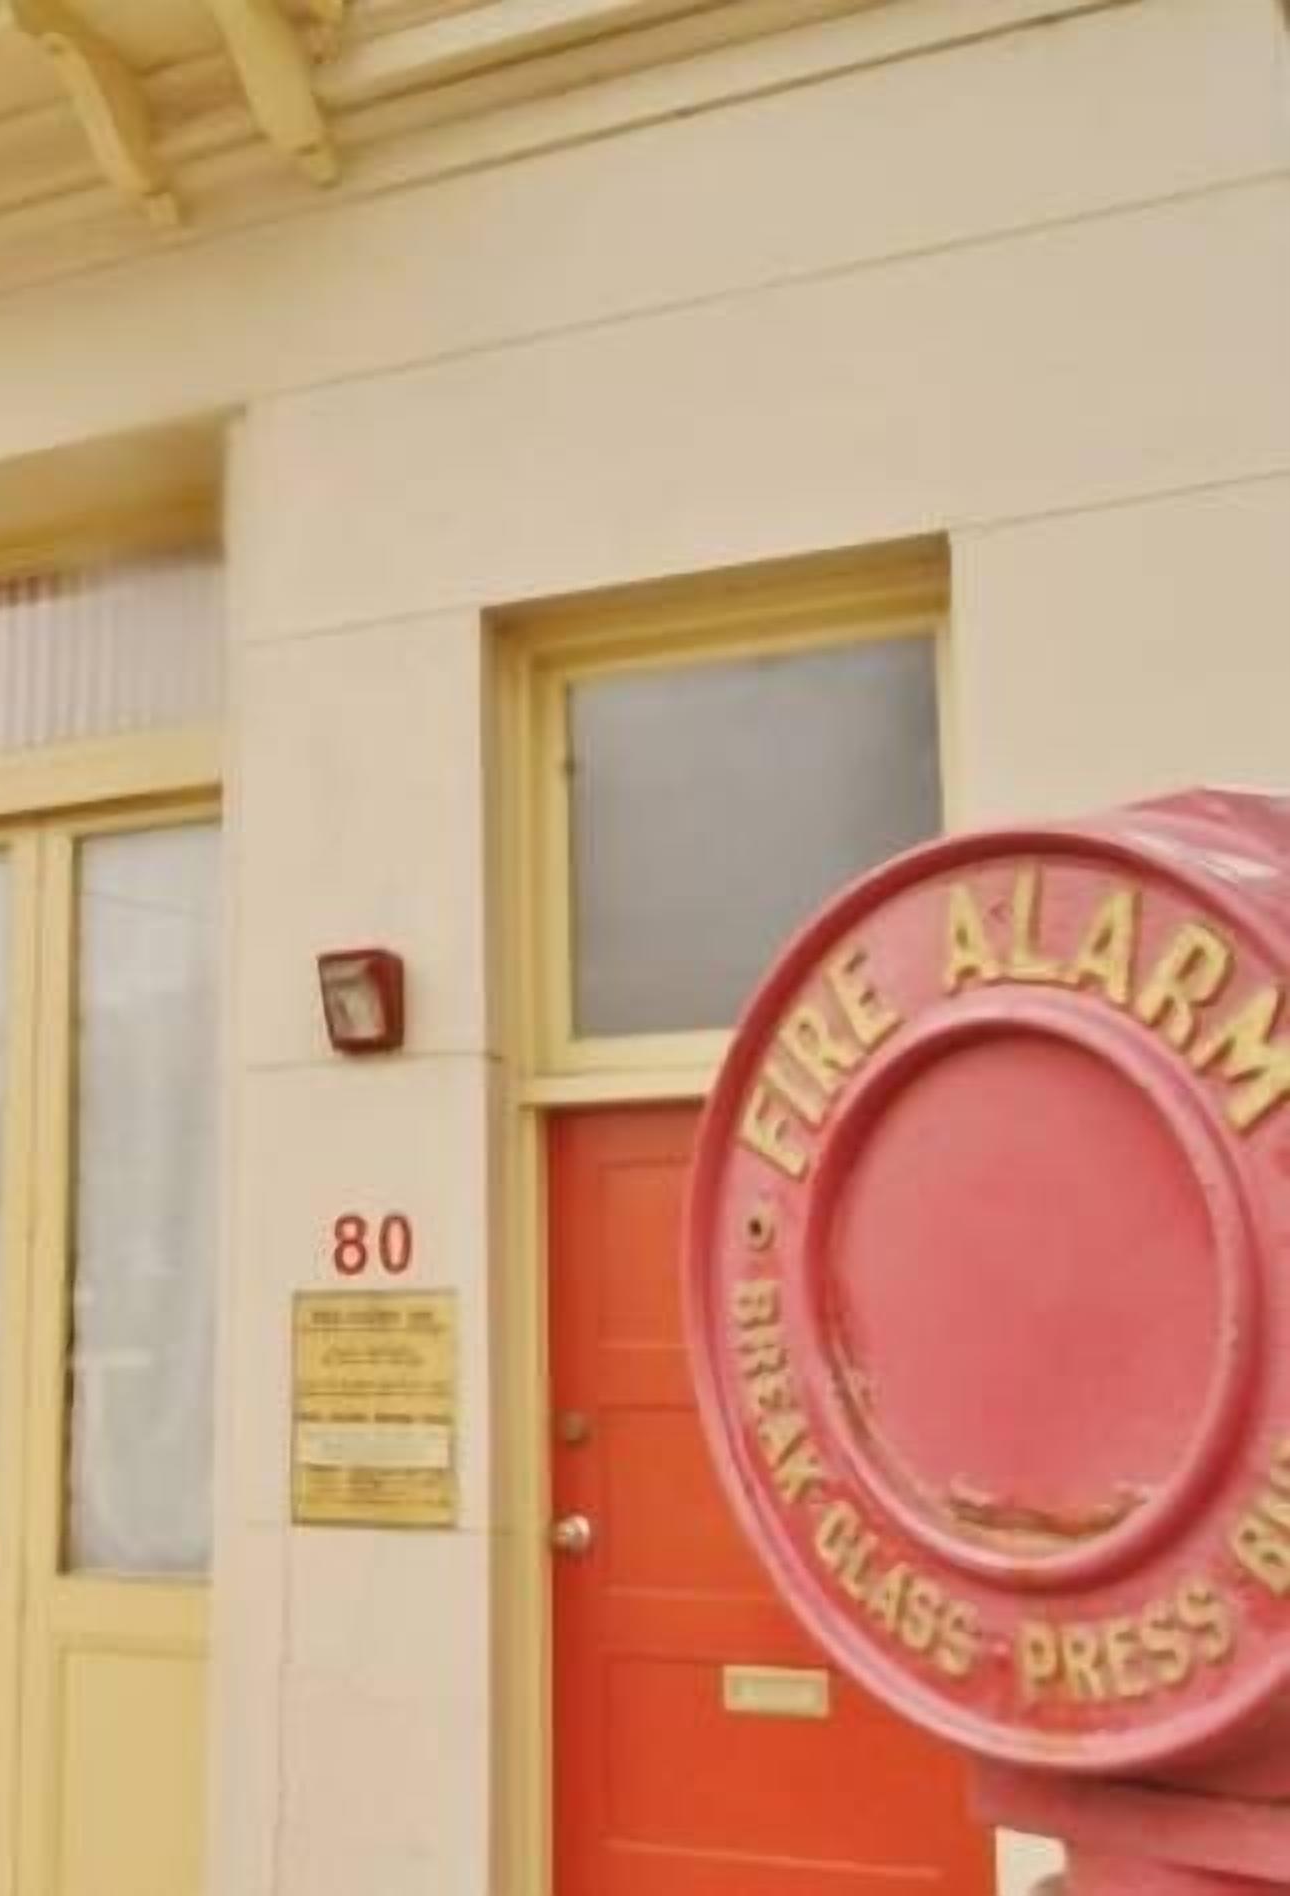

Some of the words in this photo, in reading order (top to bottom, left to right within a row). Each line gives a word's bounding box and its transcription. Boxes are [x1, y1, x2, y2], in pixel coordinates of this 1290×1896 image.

[737, 946, 906, 1180] FIRE
[944, 860, 1290, 1137] ALARM
[334, 1212, 413, 1276] 80
[734, 1279, 824, 1505] BREAK
[814, 1499, 982, 1679] GLASS
[1015, 1580, 1238, 1701] PRESS
